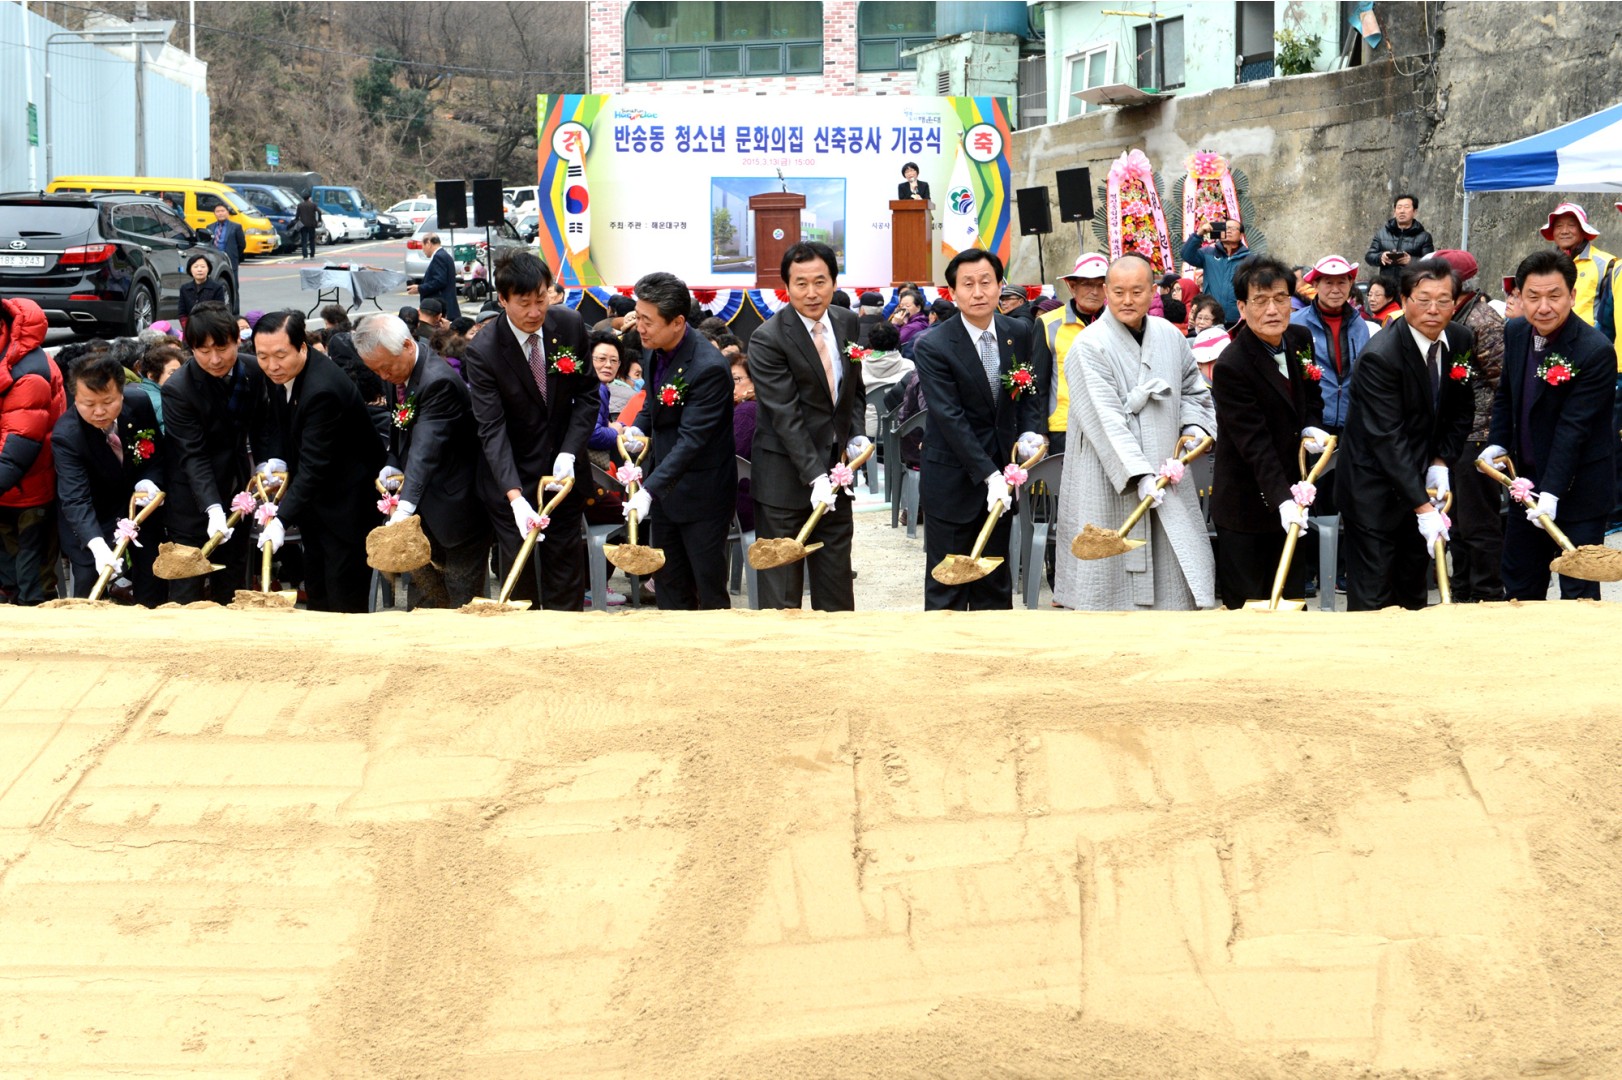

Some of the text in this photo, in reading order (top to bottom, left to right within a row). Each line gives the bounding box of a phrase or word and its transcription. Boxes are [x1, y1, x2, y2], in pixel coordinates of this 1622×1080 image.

[562, 130, 582, 152] 경
[614, 125, 941, 154] 반송동 청소년 문화의집 신축공사 기공식
[973, 132, 993, 154] 축
[742, 158, 816, 167] 2015.3.13(금) 15:00
[651, 221, 687, 230] 해운대구청
[872, 222, 891, 230] 시공사
[19, 256, 40, 265] 3243
